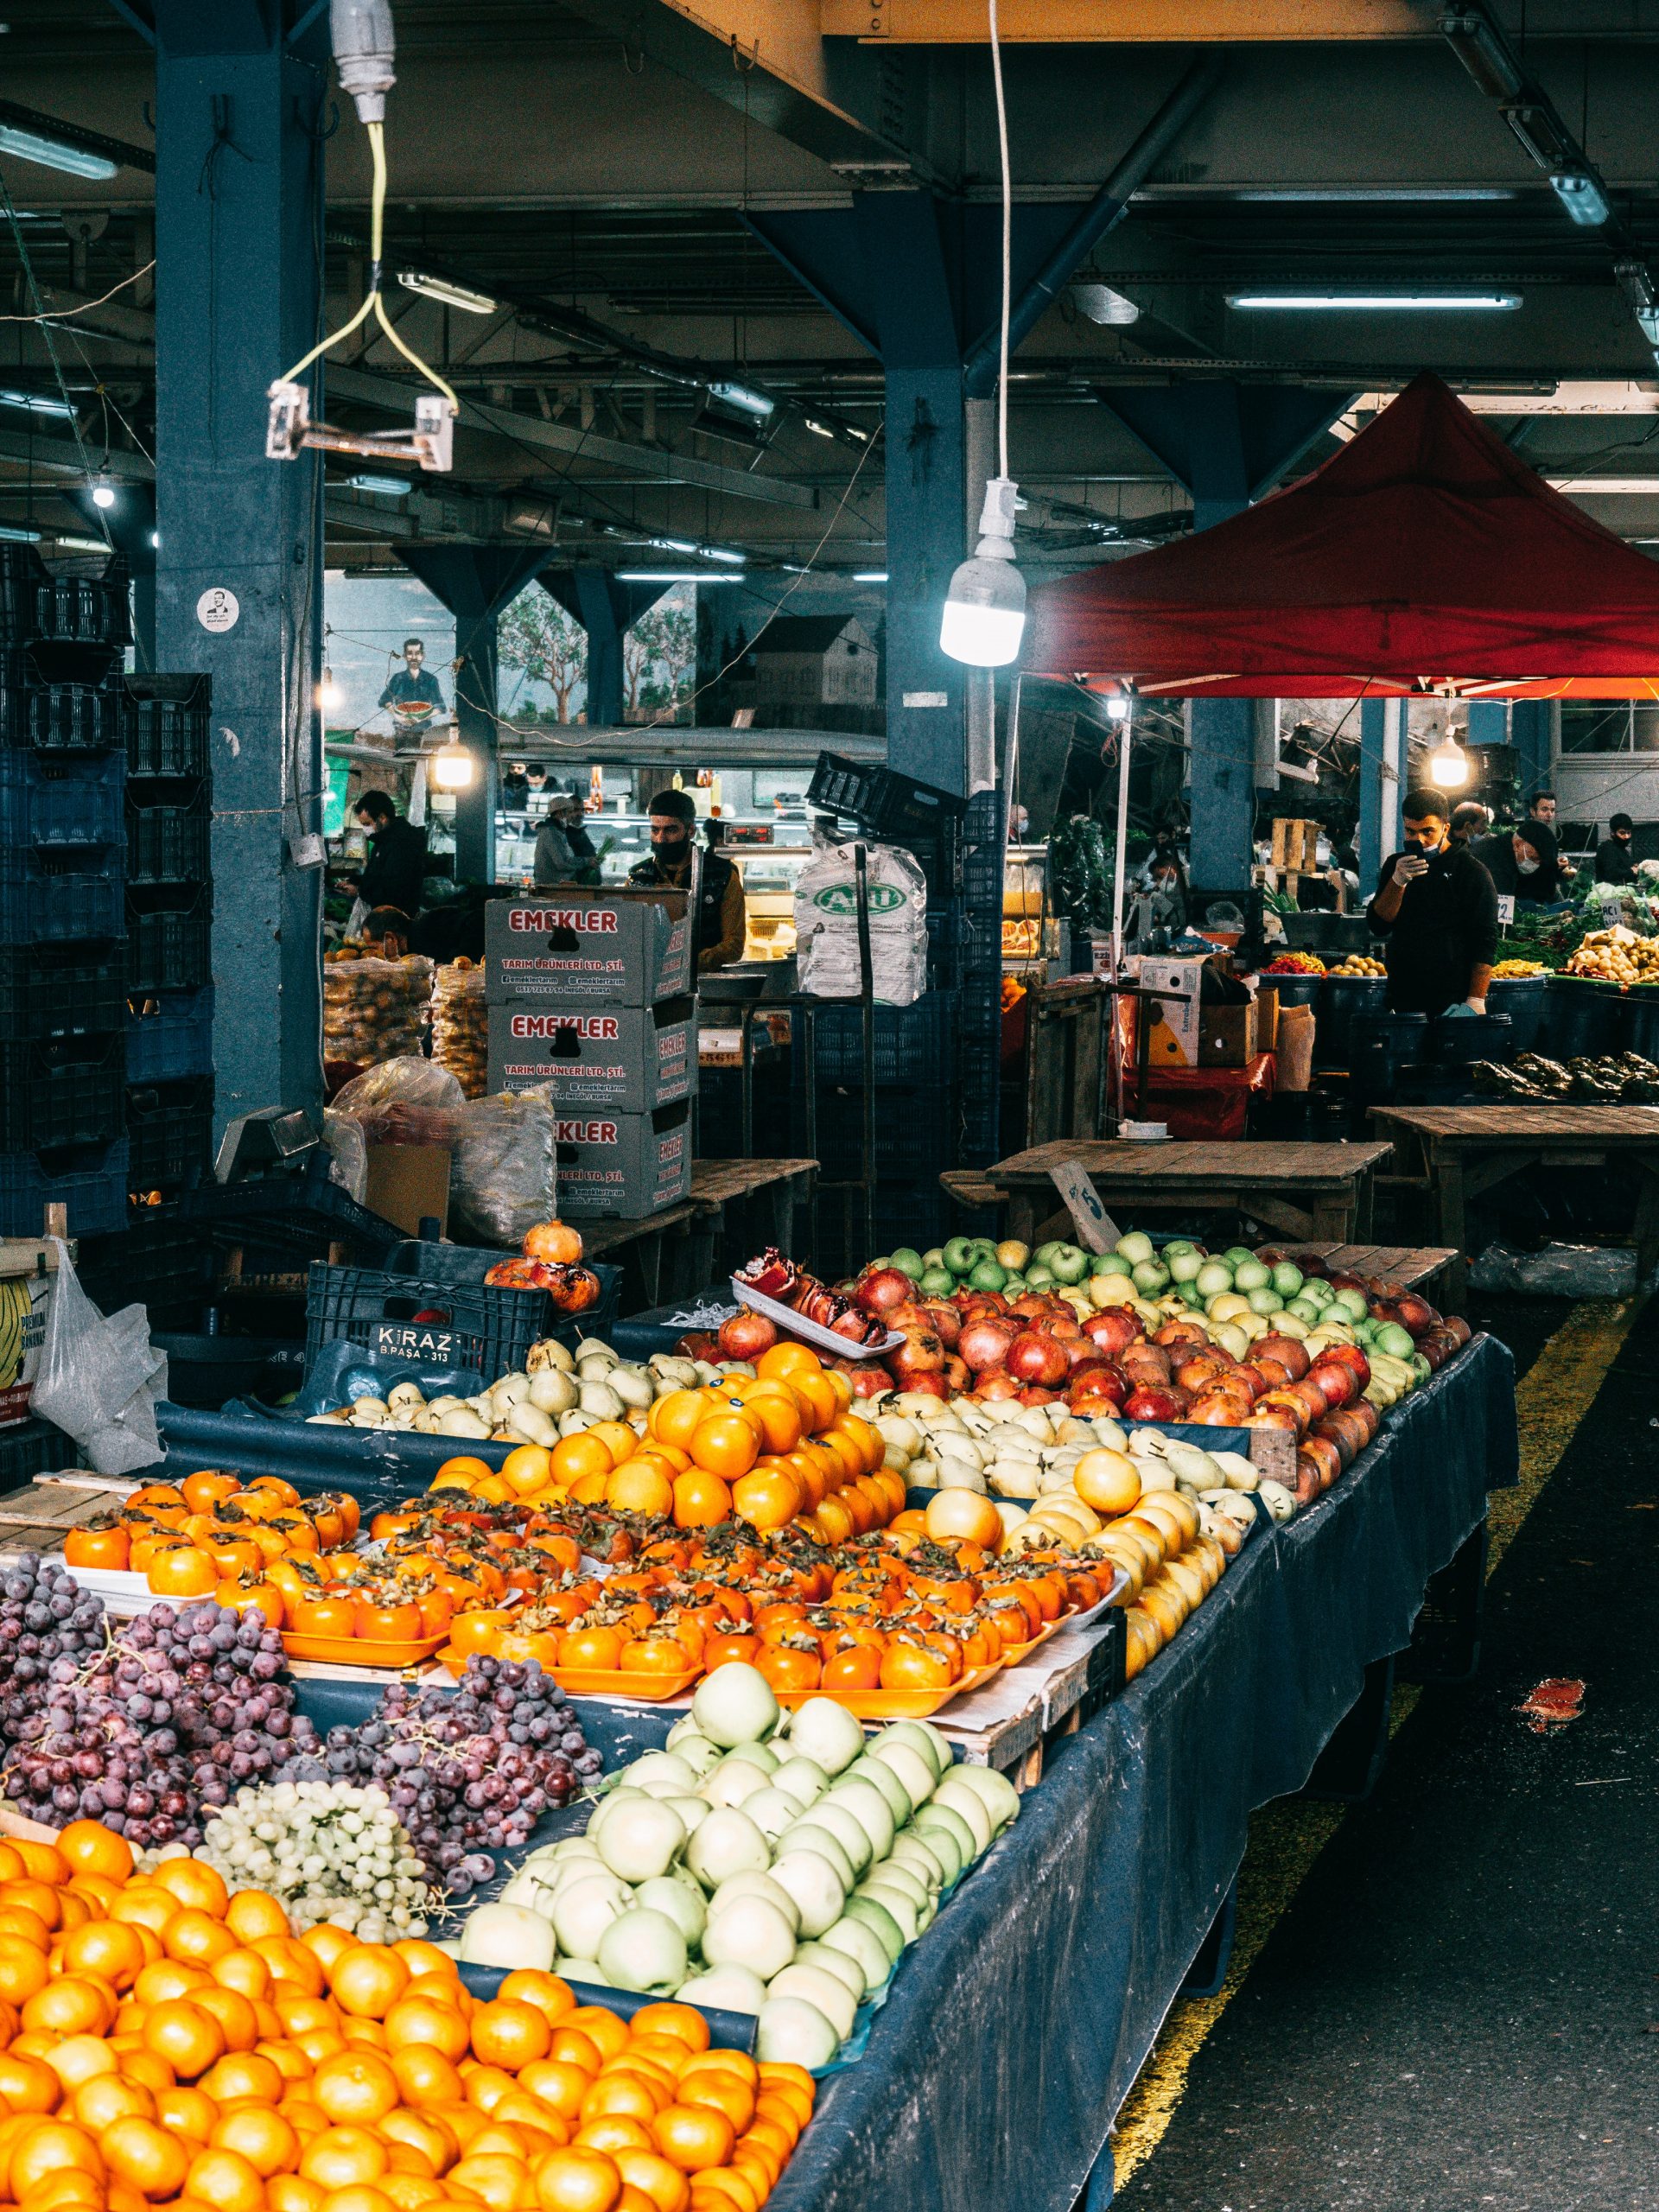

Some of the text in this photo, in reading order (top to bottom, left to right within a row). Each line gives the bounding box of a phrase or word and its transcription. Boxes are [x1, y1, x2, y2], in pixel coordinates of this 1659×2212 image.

[509, 909, 618, 932] EMEKLER
[502, 958, 625, 972] TARIM ÜRÜNLERİ LTD. ŞTİ.
[510, 976, 557, 984] emeklertarım
[577, 976, 625, 985] emeklertarım
[512, 1015, 618, 1039] EMEKLER
[505, 1065, 626, 1078] TARIM ÜRÜNLERİ LTD. ŞTİ.
[578, 1084, 626, 1092] emeklertarım
[585, 1171, 604, 1181] LTD.
[606, 1170, 624, 1183] ŞTİ.
[380, 1345, 420, 1359] B.PAŞA
[431, 1352, 448, 1362] 313
